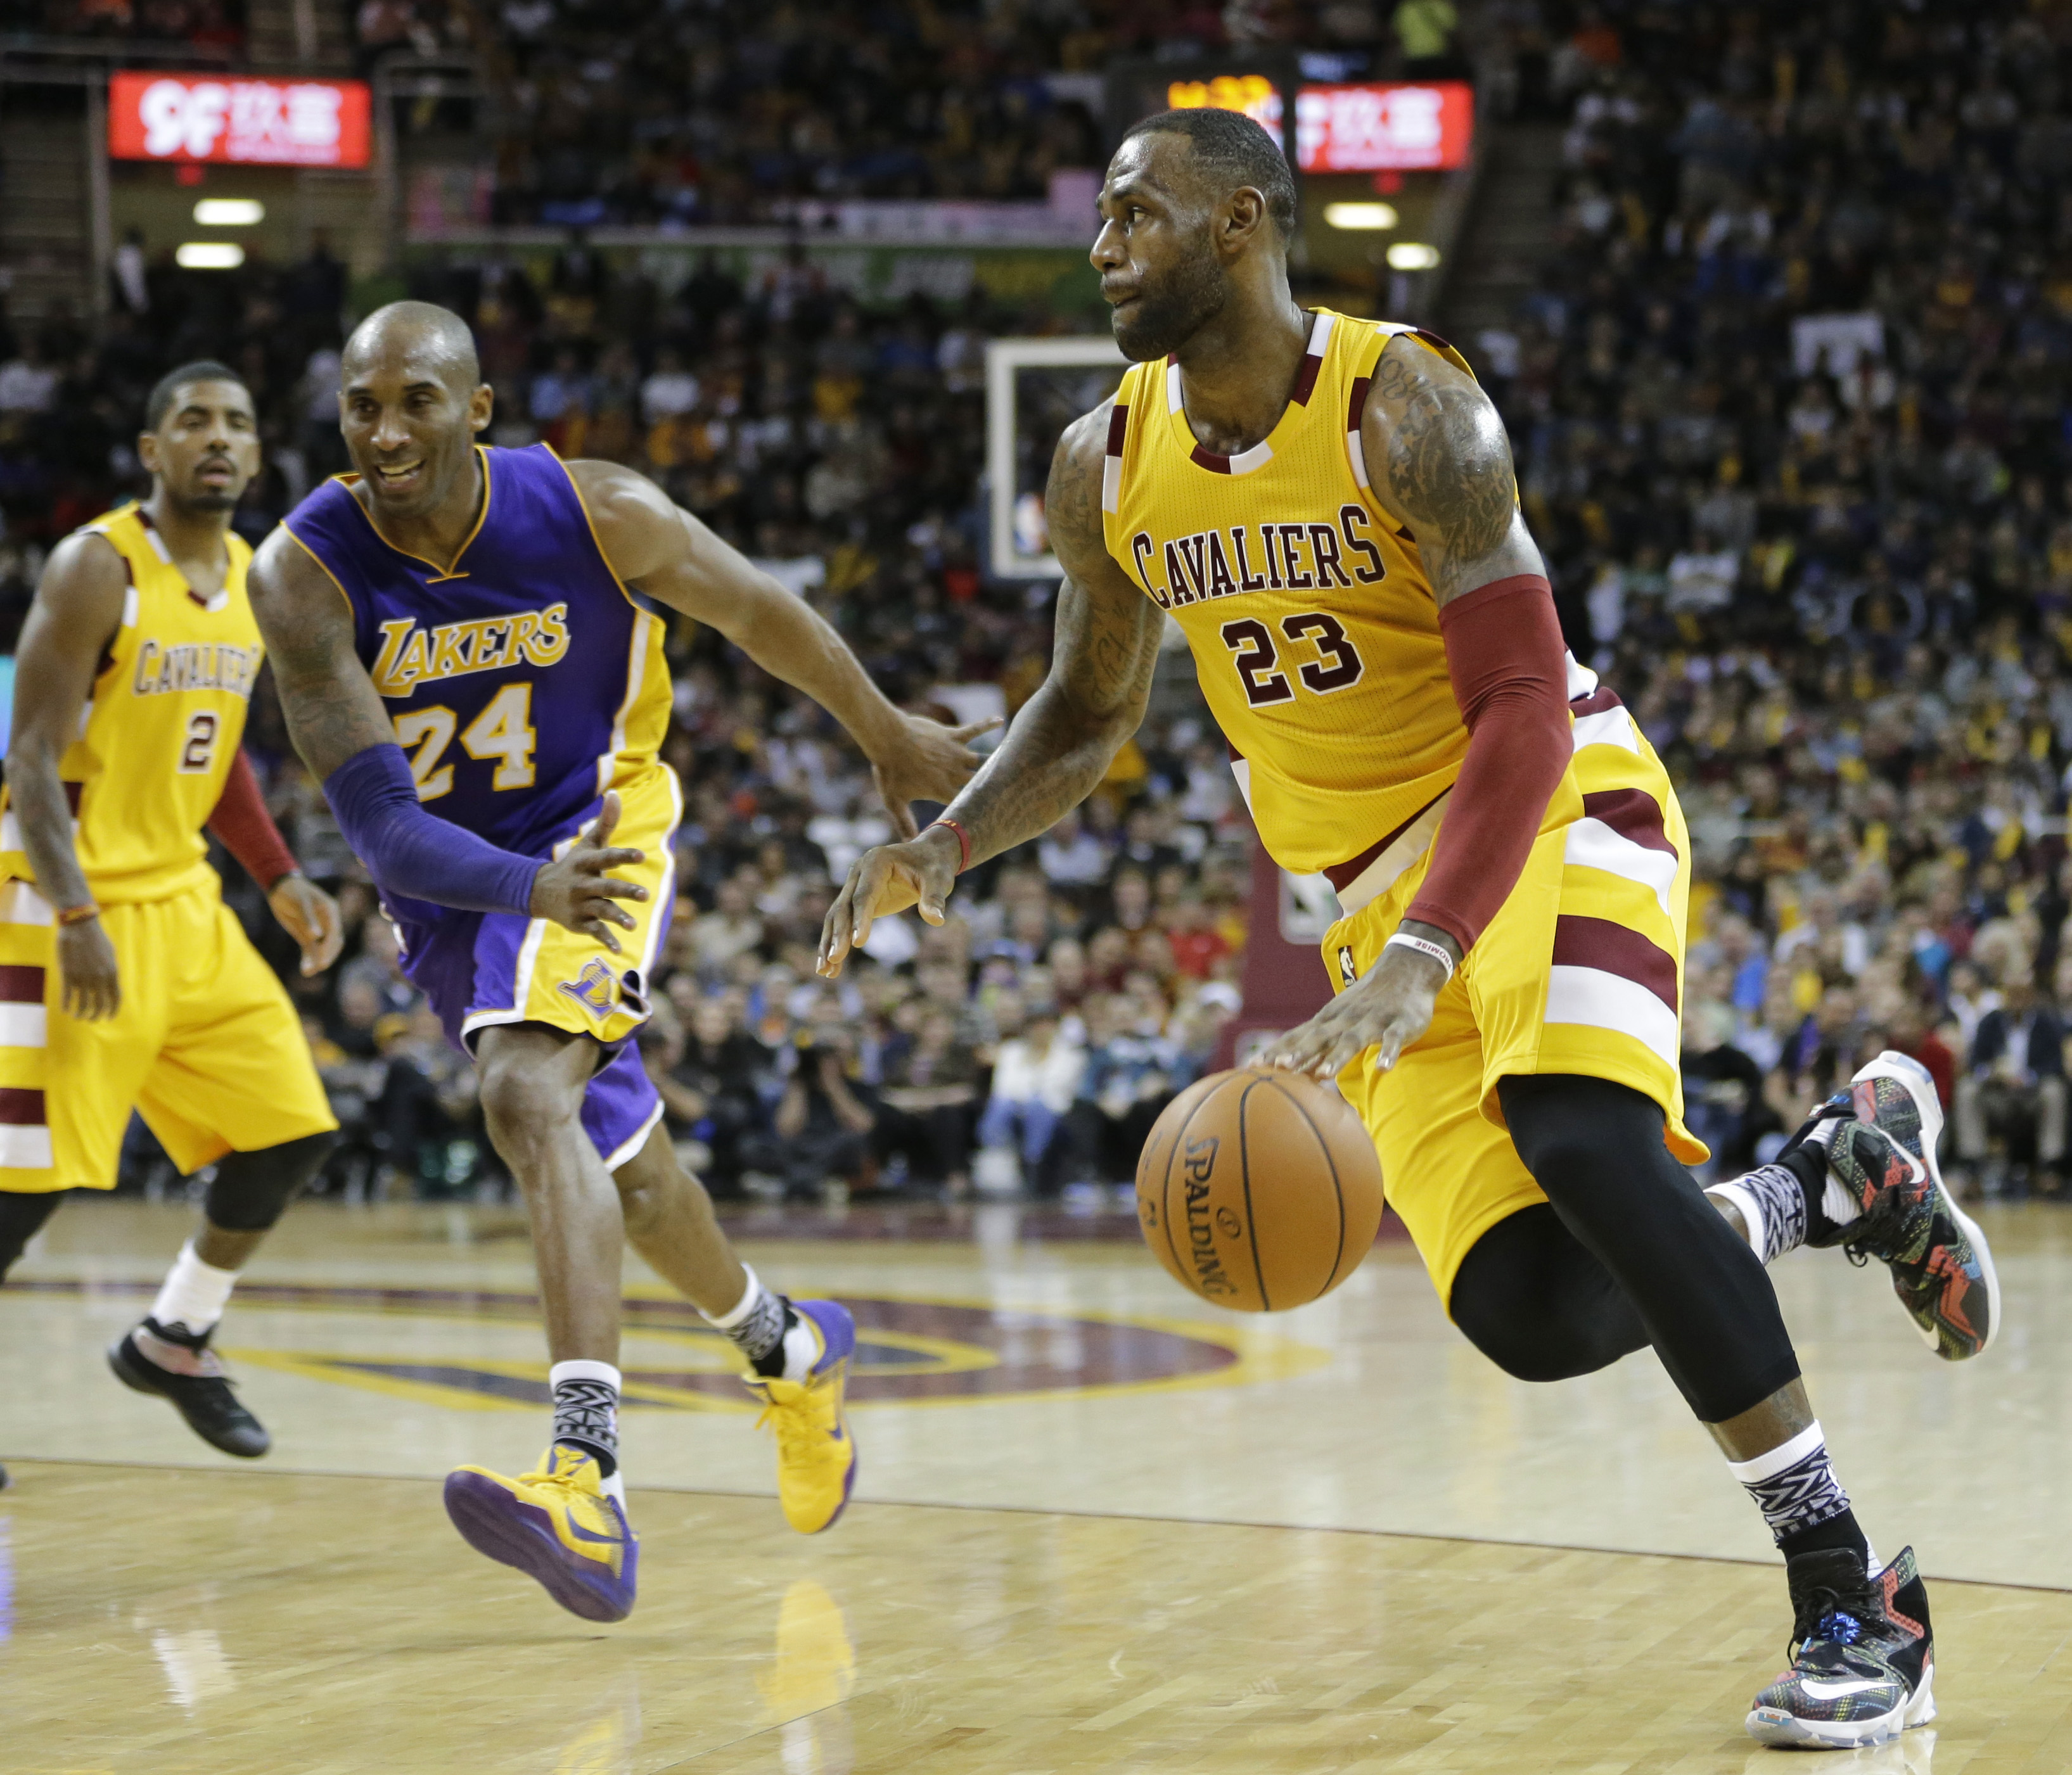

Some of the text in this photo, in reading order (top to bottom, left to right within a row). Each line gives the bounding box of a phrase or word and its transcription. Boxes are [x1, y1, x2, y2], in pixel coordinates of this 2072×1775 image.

[1131, 503, 1386, 611] CAVALIERS
[371, 601, 572, 698] LAKERS
[1219, 612, 1365, 709] 23
[176, 709, 221, 775] 2
[393, 682, 537, 803] 24
[1185, 1136, 1239, 1296] SPALDING
